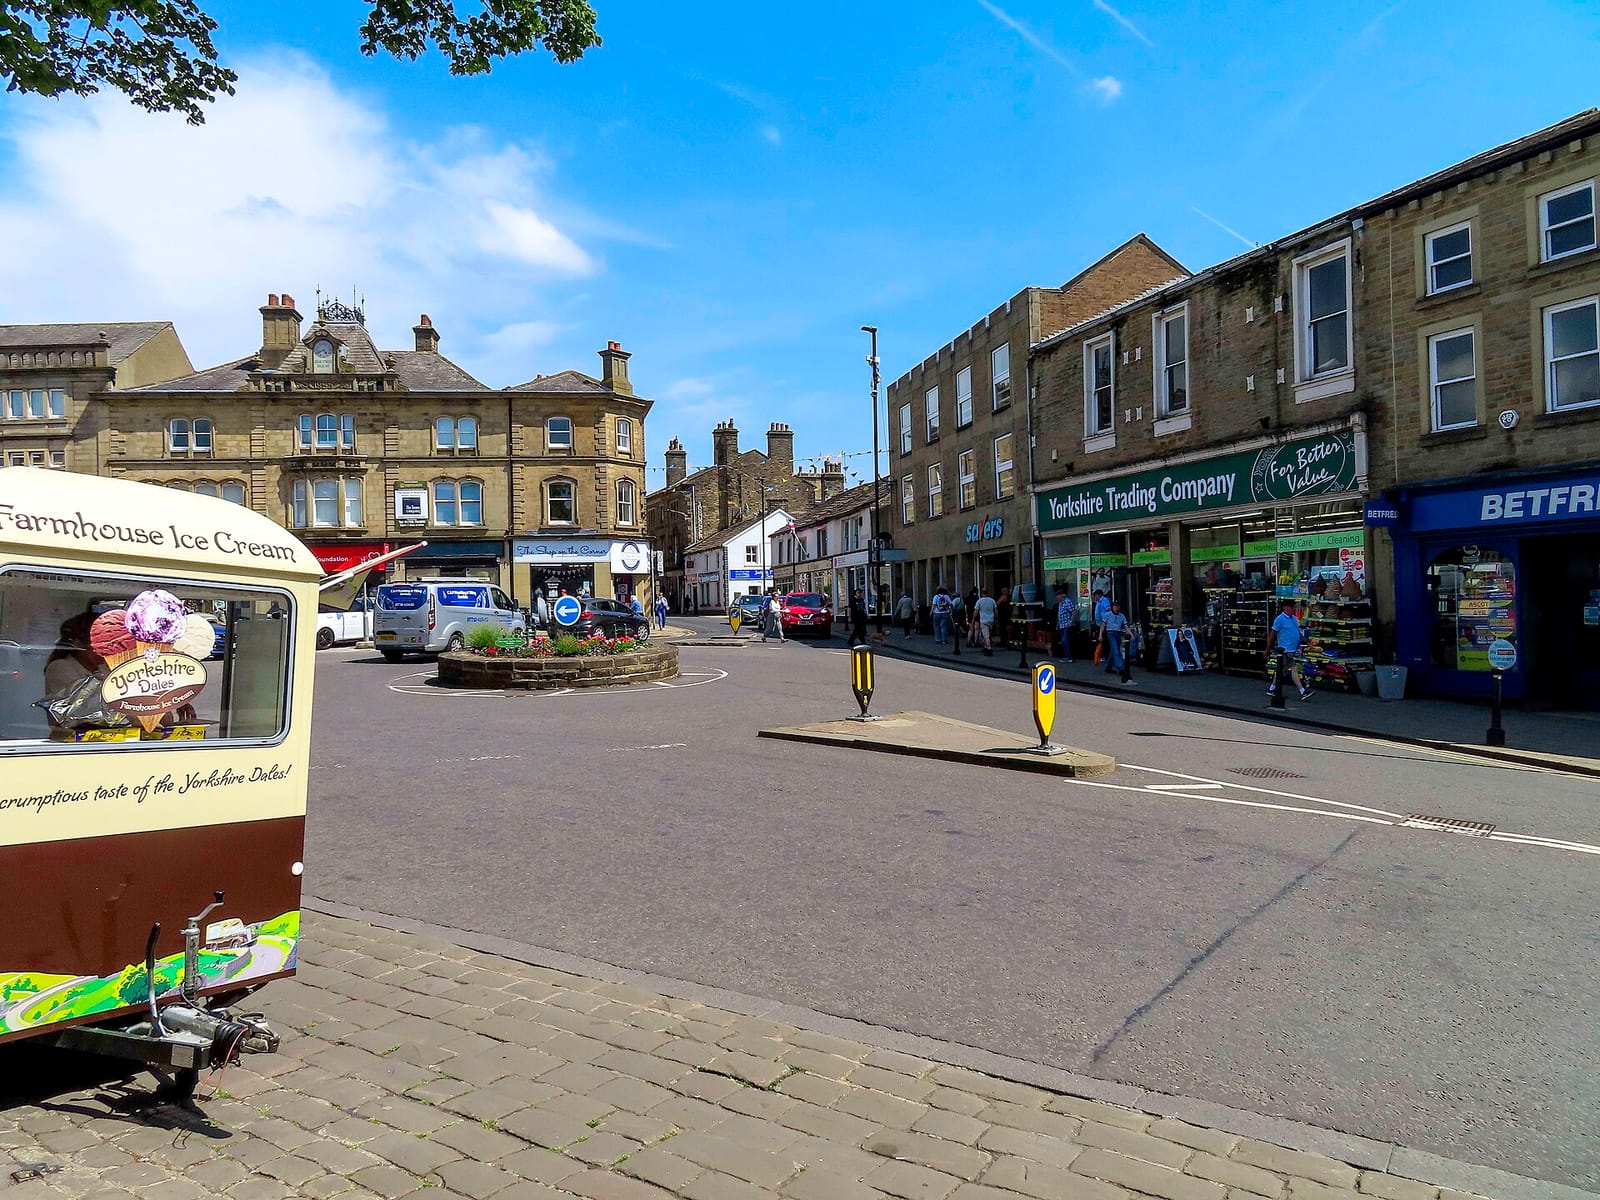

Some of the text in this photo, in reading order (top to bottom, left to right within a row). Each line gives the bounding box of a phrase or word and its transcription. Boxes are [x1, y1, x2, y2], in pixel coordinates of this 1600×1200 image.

[1270, 441, 1341, 482] For Better
[1287, 467, 1328, 493] Value
[1049, 473, 1236, 520] Yorkshire Trading Company
[1480, 484, 1600, 521] BETFR
[1368, 510, 1399, 519] BETFRED
[0, 503, 297, 563] Farmhouse Ice Cream
[1279, 534, 1360, 550] Baby Care Cleaning
[516, 545, 534, 556] The
[536, 545, 556, 558] Shop
[565, 545, 578, 556] the
[579, 545, 608, 556] Corner
[111, 659, 196, 695] Yorkshire
[138, 678, 175, 693] Dales
[119, 700, 161, 712] Farmhouse
[172, 690, 195, 704] Cream
[94, 783, 129, 801] taste
[133, 775, 155, 803] of
[153, 774, 174, 795] the
[178, 768, 245, 795] Yorkshire
[248, 764, 292, 782] Dales!
